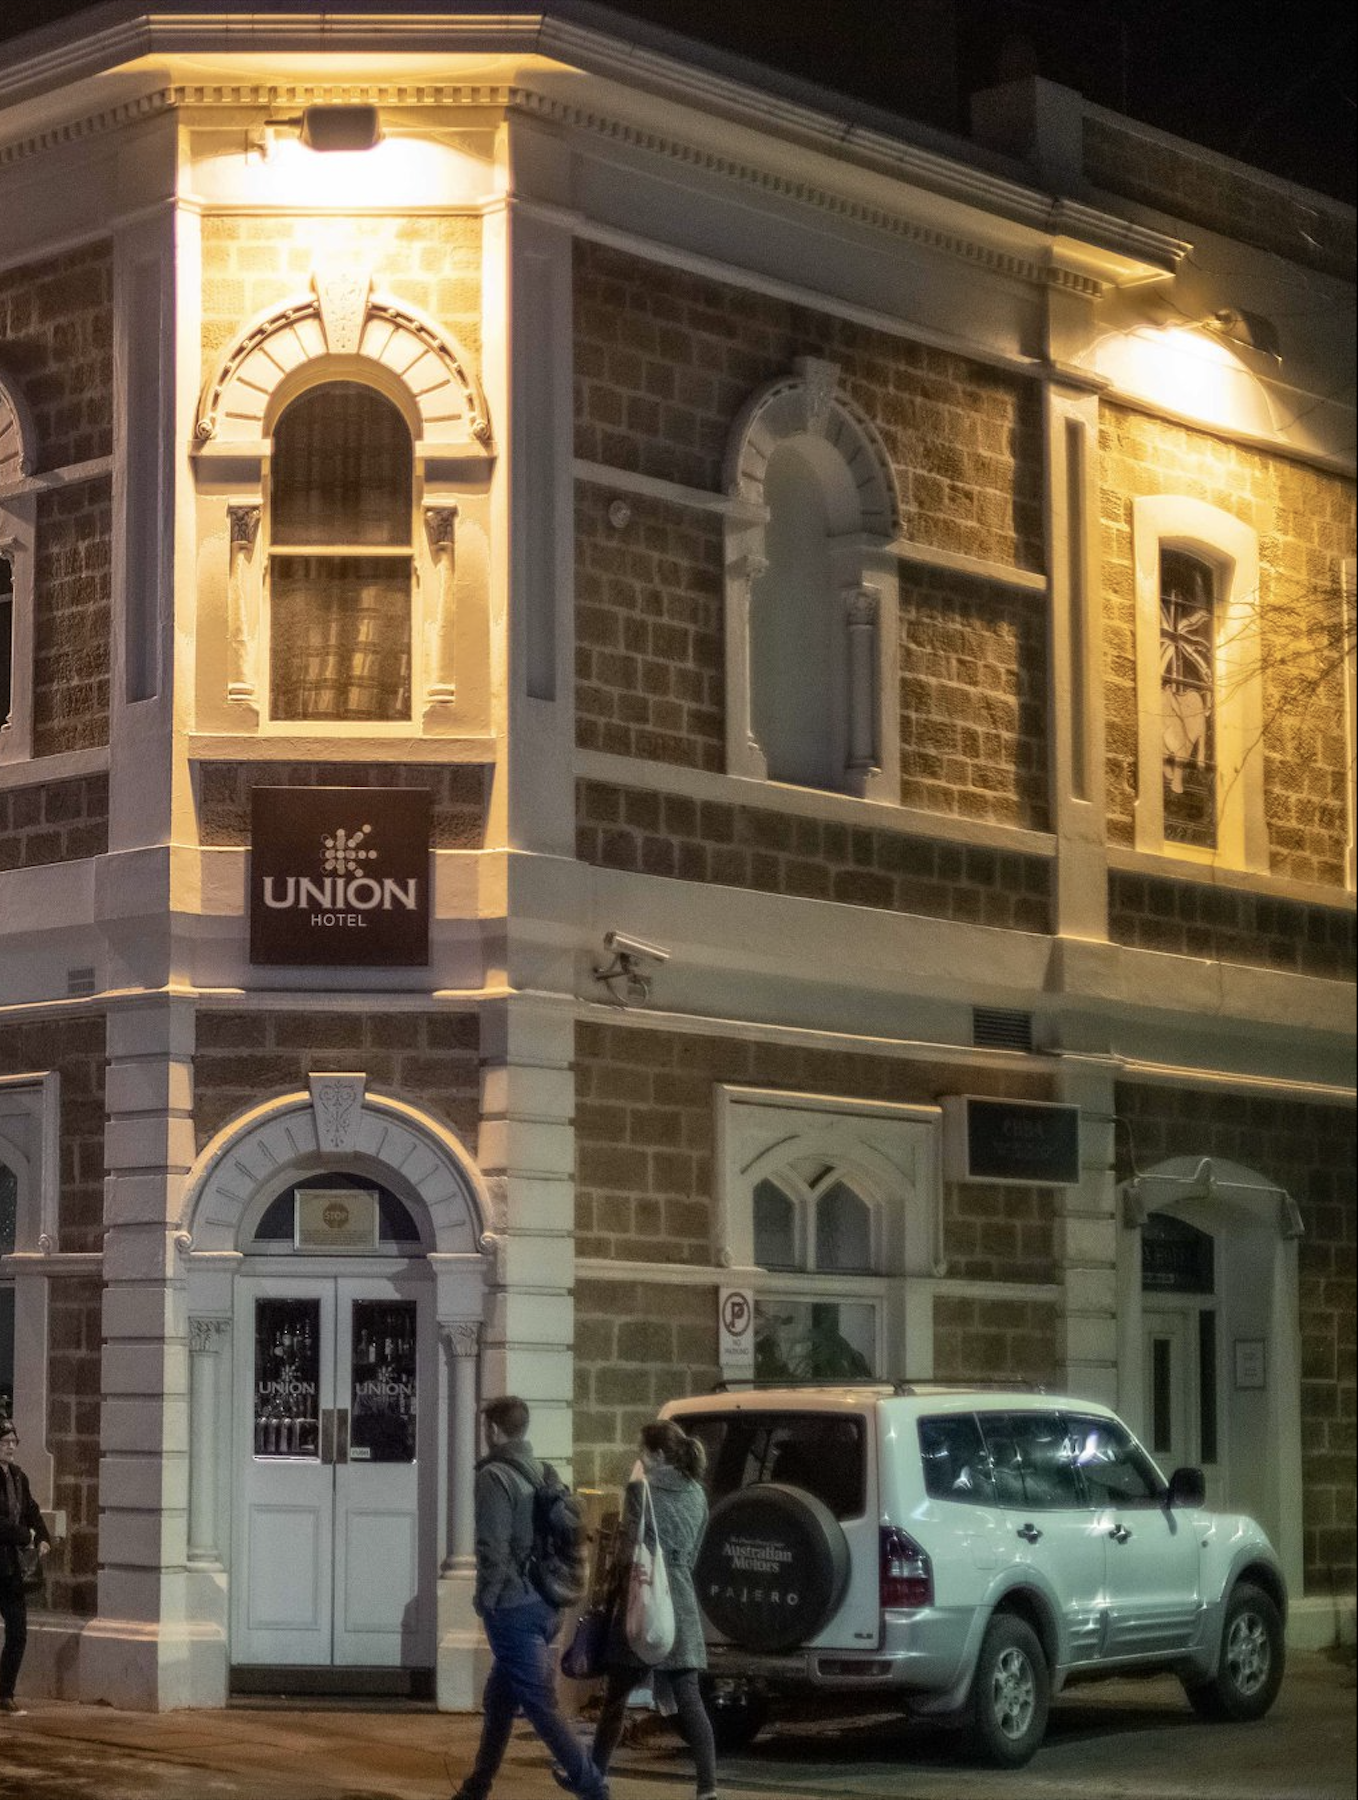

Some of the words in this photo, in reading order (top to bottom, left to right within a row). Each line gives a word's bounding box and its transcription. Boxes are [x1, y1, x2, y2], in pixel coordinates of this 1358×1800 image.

[262, 876, 417, 910] UNION
[311, 913, 368, 927] HOTEL
[324, 1211, 349, 1221] STOP
[258, 1381, 316, 1395] UNION
[355, 1382, 412, 1396] UNION
[723, 1542, 793, 1563] Australian
[731, 1556, 780, 1574] Motors
[710, 1584, 798, 1606] PAJERO
